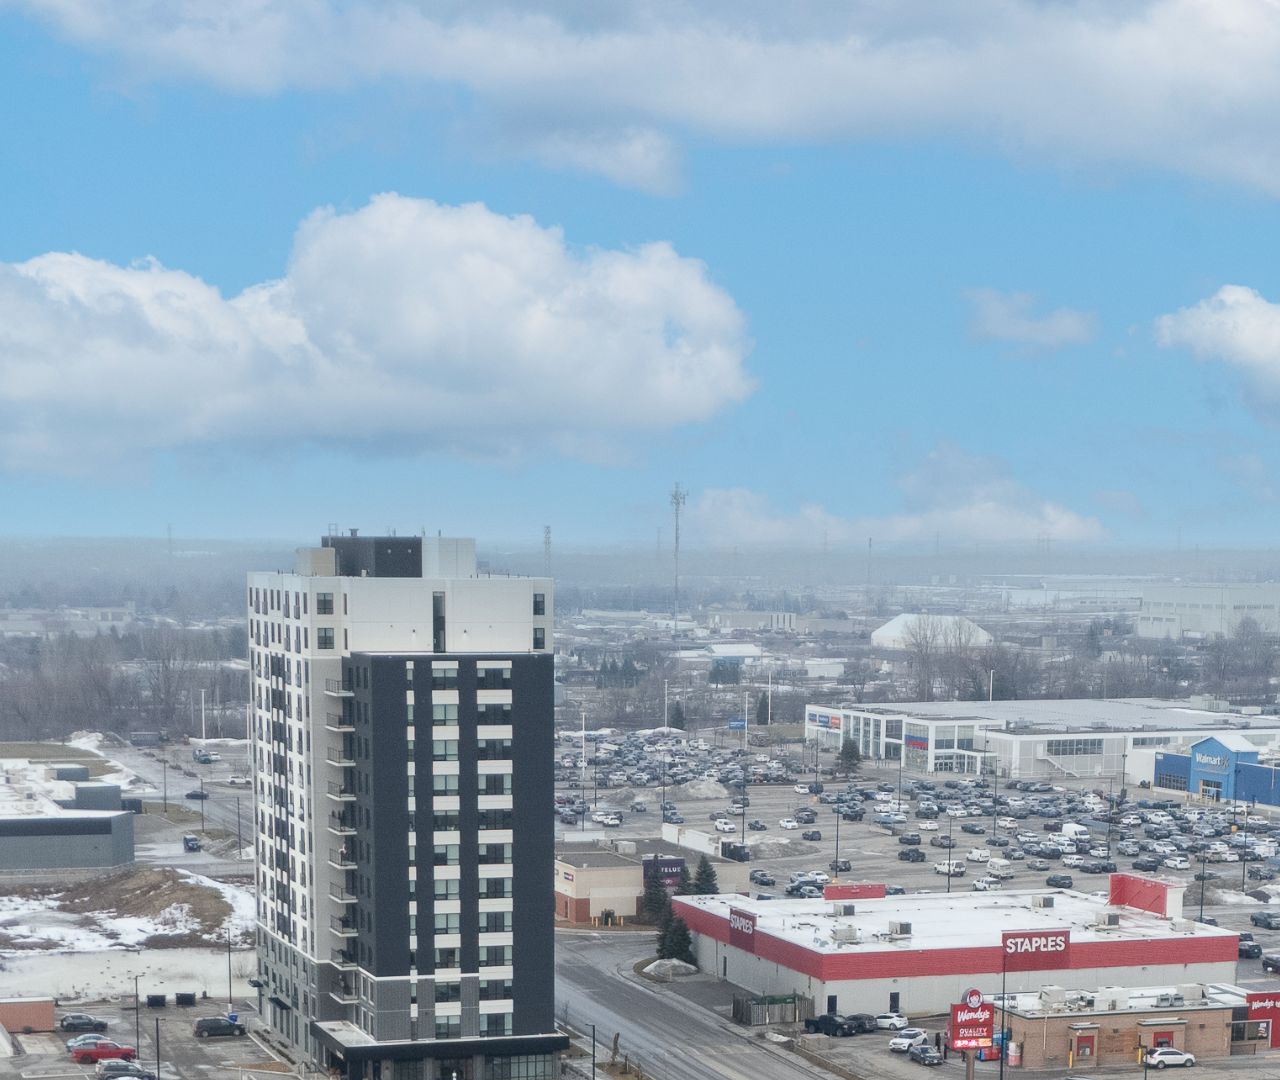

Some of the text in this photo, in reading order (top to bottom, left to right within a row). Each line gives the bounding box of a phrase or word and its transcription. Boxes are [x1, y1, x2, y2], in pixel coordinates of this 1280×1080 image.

[1196, 752, 1221, 765] Walmart
[730, 914, 753, 935] STAPLES
[1006, 936, 1066, 953] STAPLES
[957, 1007, 990, 1023] Wendy's
